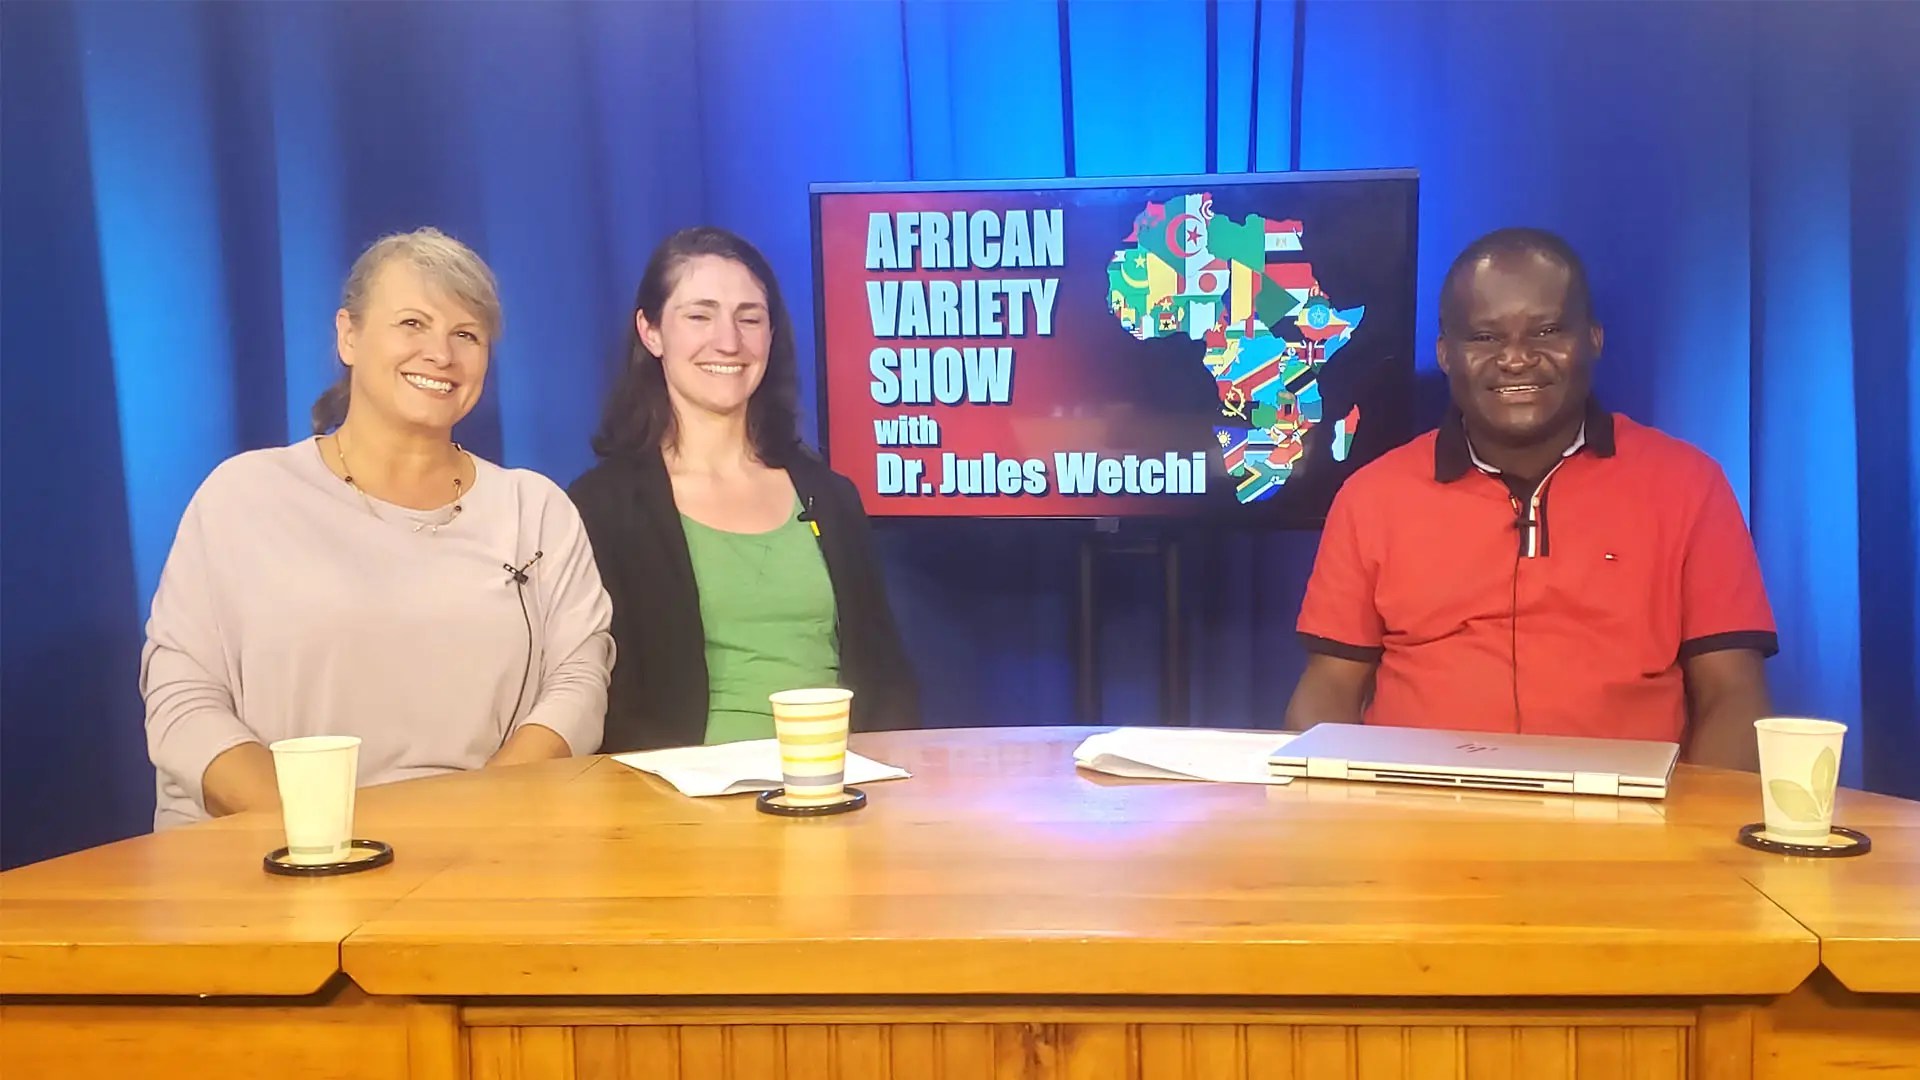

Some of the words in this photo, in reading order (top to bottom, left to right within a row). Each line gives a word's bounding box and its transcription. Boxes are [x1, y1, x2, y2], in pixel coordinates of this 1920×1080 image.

[866, 209, 1064, 270] AFRICAN
[866, 278, 1060, 338] VARIETY
[869, 347, 1014, 405] SHOW
[874, 415, 939, 447] with
[876, 453, 933, 495] Dr.
[939, 453, 1048, 496] Jules
[1054, 452, 1207, 495] Wetchi
